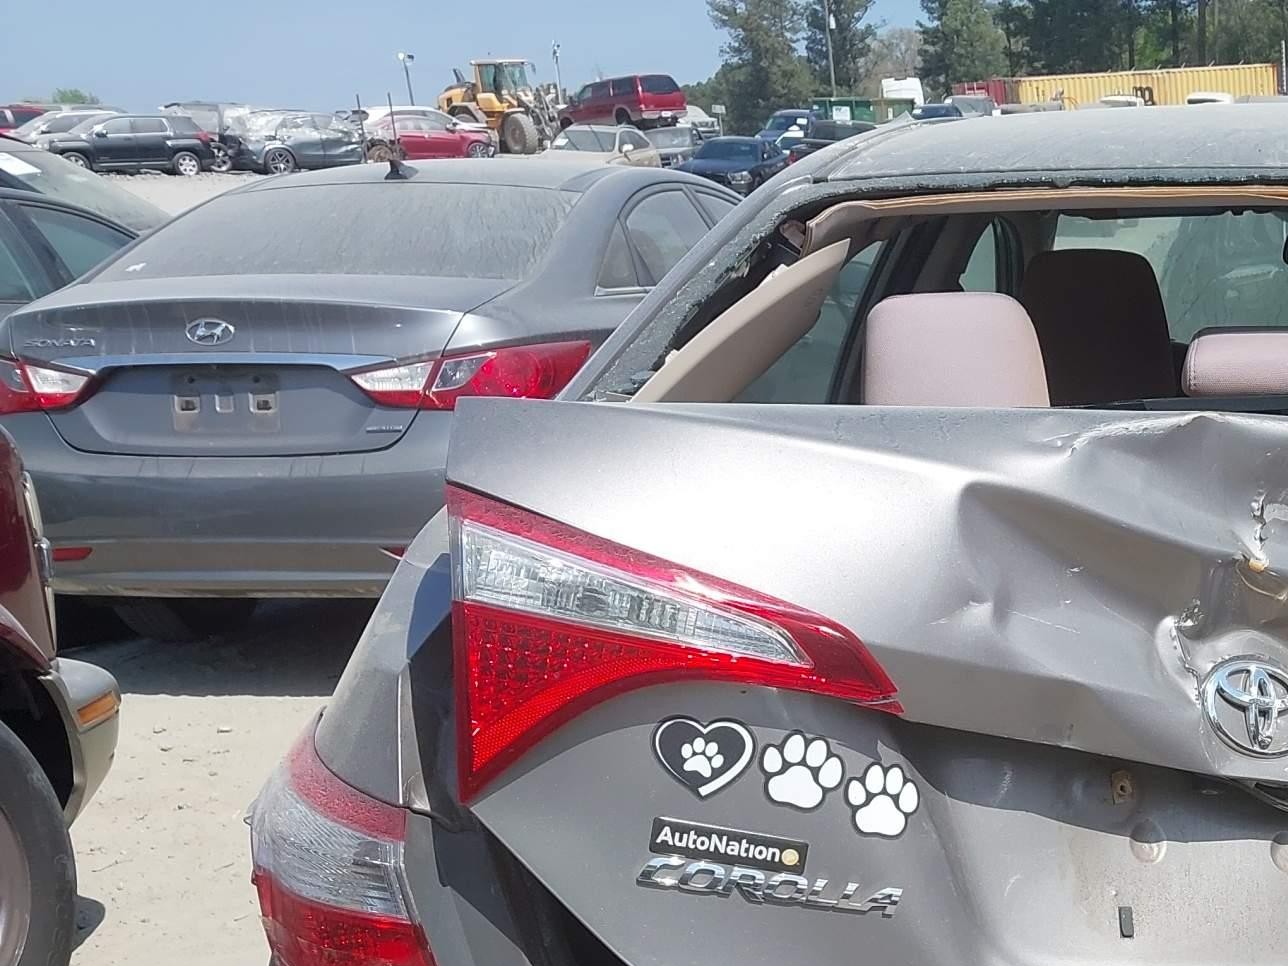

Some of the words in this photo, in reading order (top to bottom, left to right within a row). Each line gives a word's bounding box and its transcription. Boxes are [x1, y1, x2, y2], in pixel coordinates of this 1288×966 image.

[23, 337, 97, 349] SONATA
[655, 824, 781, 863] AutoNation
[636, 855, 904, 919] COROLLA
